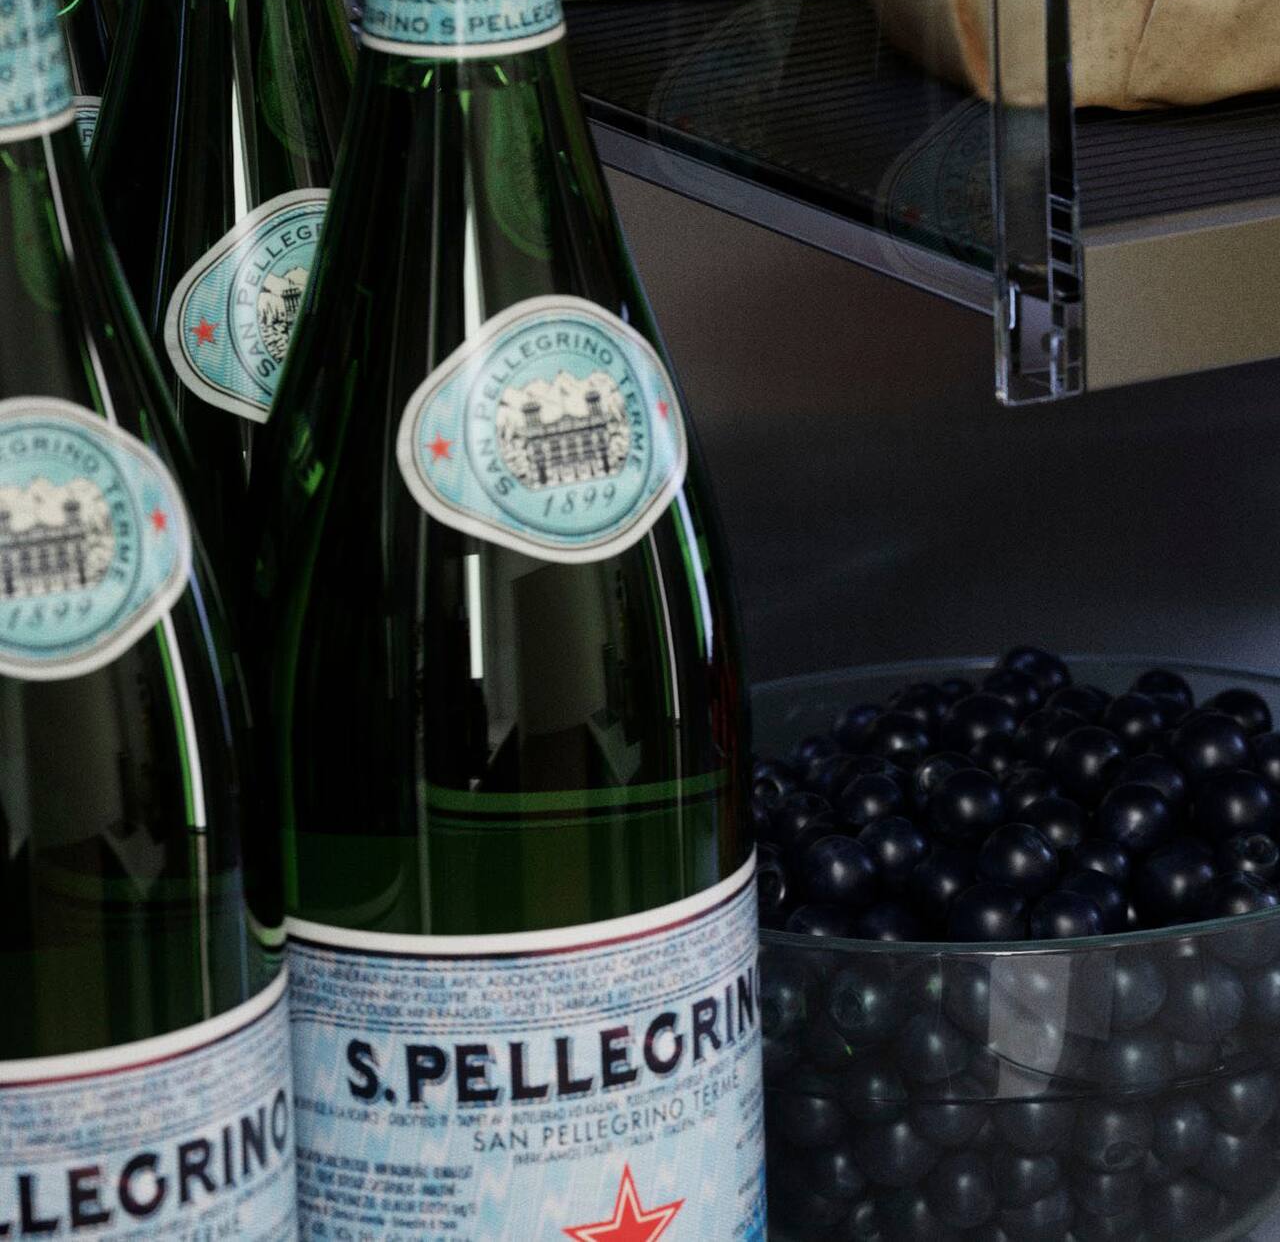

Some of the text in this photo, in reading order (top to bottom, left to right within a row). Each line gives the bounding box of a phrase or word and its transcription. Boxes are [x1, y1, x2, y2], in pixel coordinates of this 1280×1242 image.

[243, 327, 276, 379] SAN
[478, 330, 615, 423] PELLEGRINO
[481, 436, 517, 498] SAN
[543, 481, 617, 519] 1899
[345, 965, 760, 1105] S.PELLEGRIN
[473, 1129, 529, 1154] SAN
[541, 1099, 686, 1147] PELLEGRINO
[693, 1070, 742, 1113] TERME
[0, 1088, 290, 1237] LEGRINO
